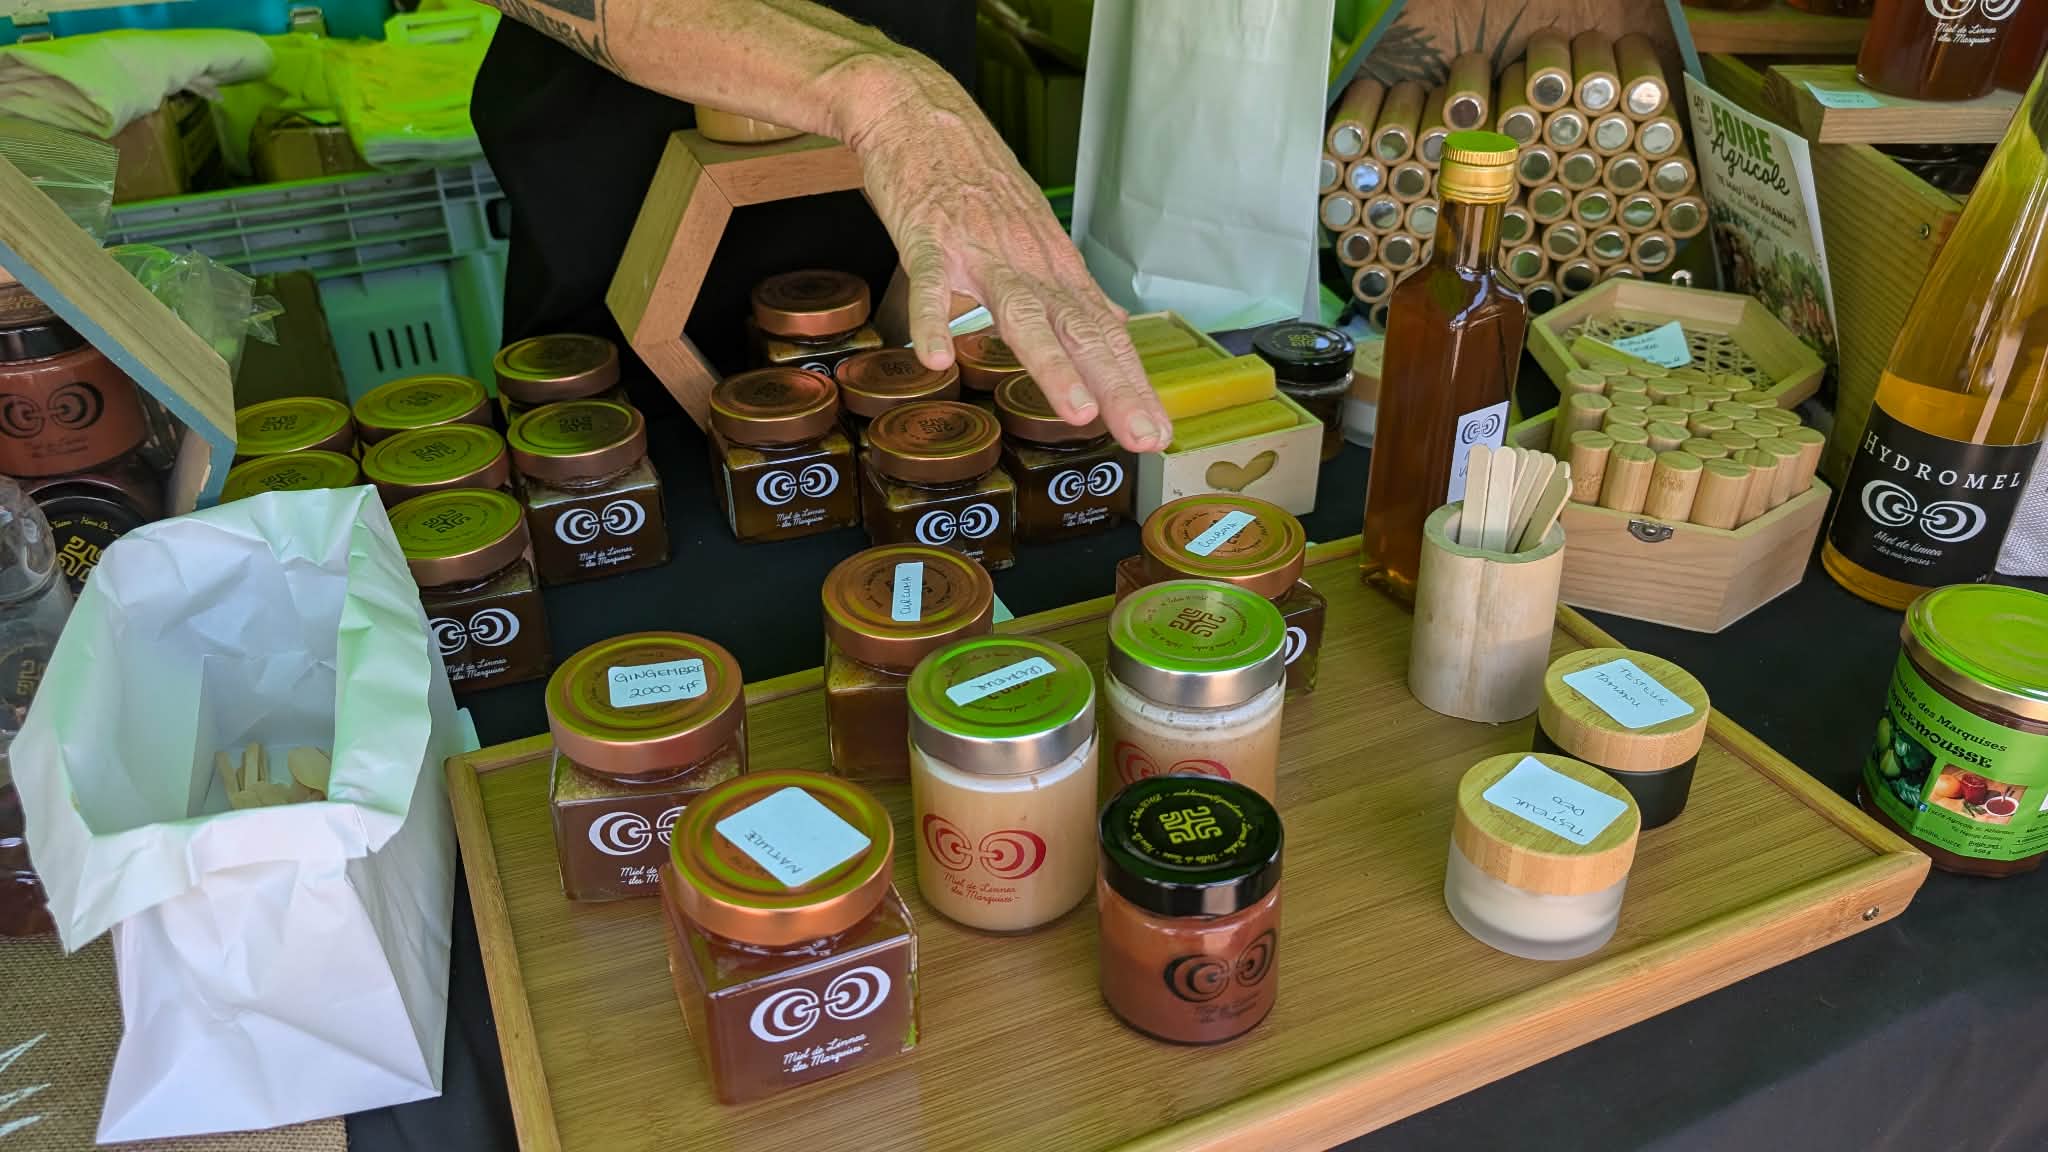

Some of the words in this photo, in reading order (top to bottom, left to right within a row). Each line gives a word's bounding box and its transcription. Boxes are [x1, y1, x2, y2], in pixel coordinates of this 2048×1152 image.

[1935, 23, 1958, 32] Miel
[1711, 102, 1775, 165] FOIRE
[1711, 132, 1791, 196] Agricole
[1864, 431, 2021, 490] HYDROMEL
[1873, 531, 1898, 545] Miel
[1896, 540, 1911, 549] de
[614, 663, 704, 683] GINGEMBRE
[1619, 666, 1669, 707] TESTEUR
[629, 684, 672, 699] 2000
[1918, 702, 1937, 719] des
[1937, 715, 2008, 752] Marquises
[1512, 796, 1585, 837] TESTEUR
[744, 829, 804, 875] NATURE
[620, 865, 644, 877] Miel
[646, 865, 658, 875] de
[944, 871, 965, 887] Miel
[967, 881, 977, 890] de
[783, 1047, 811, 1065] Miel
[811, 1045, 824, 1056] de
